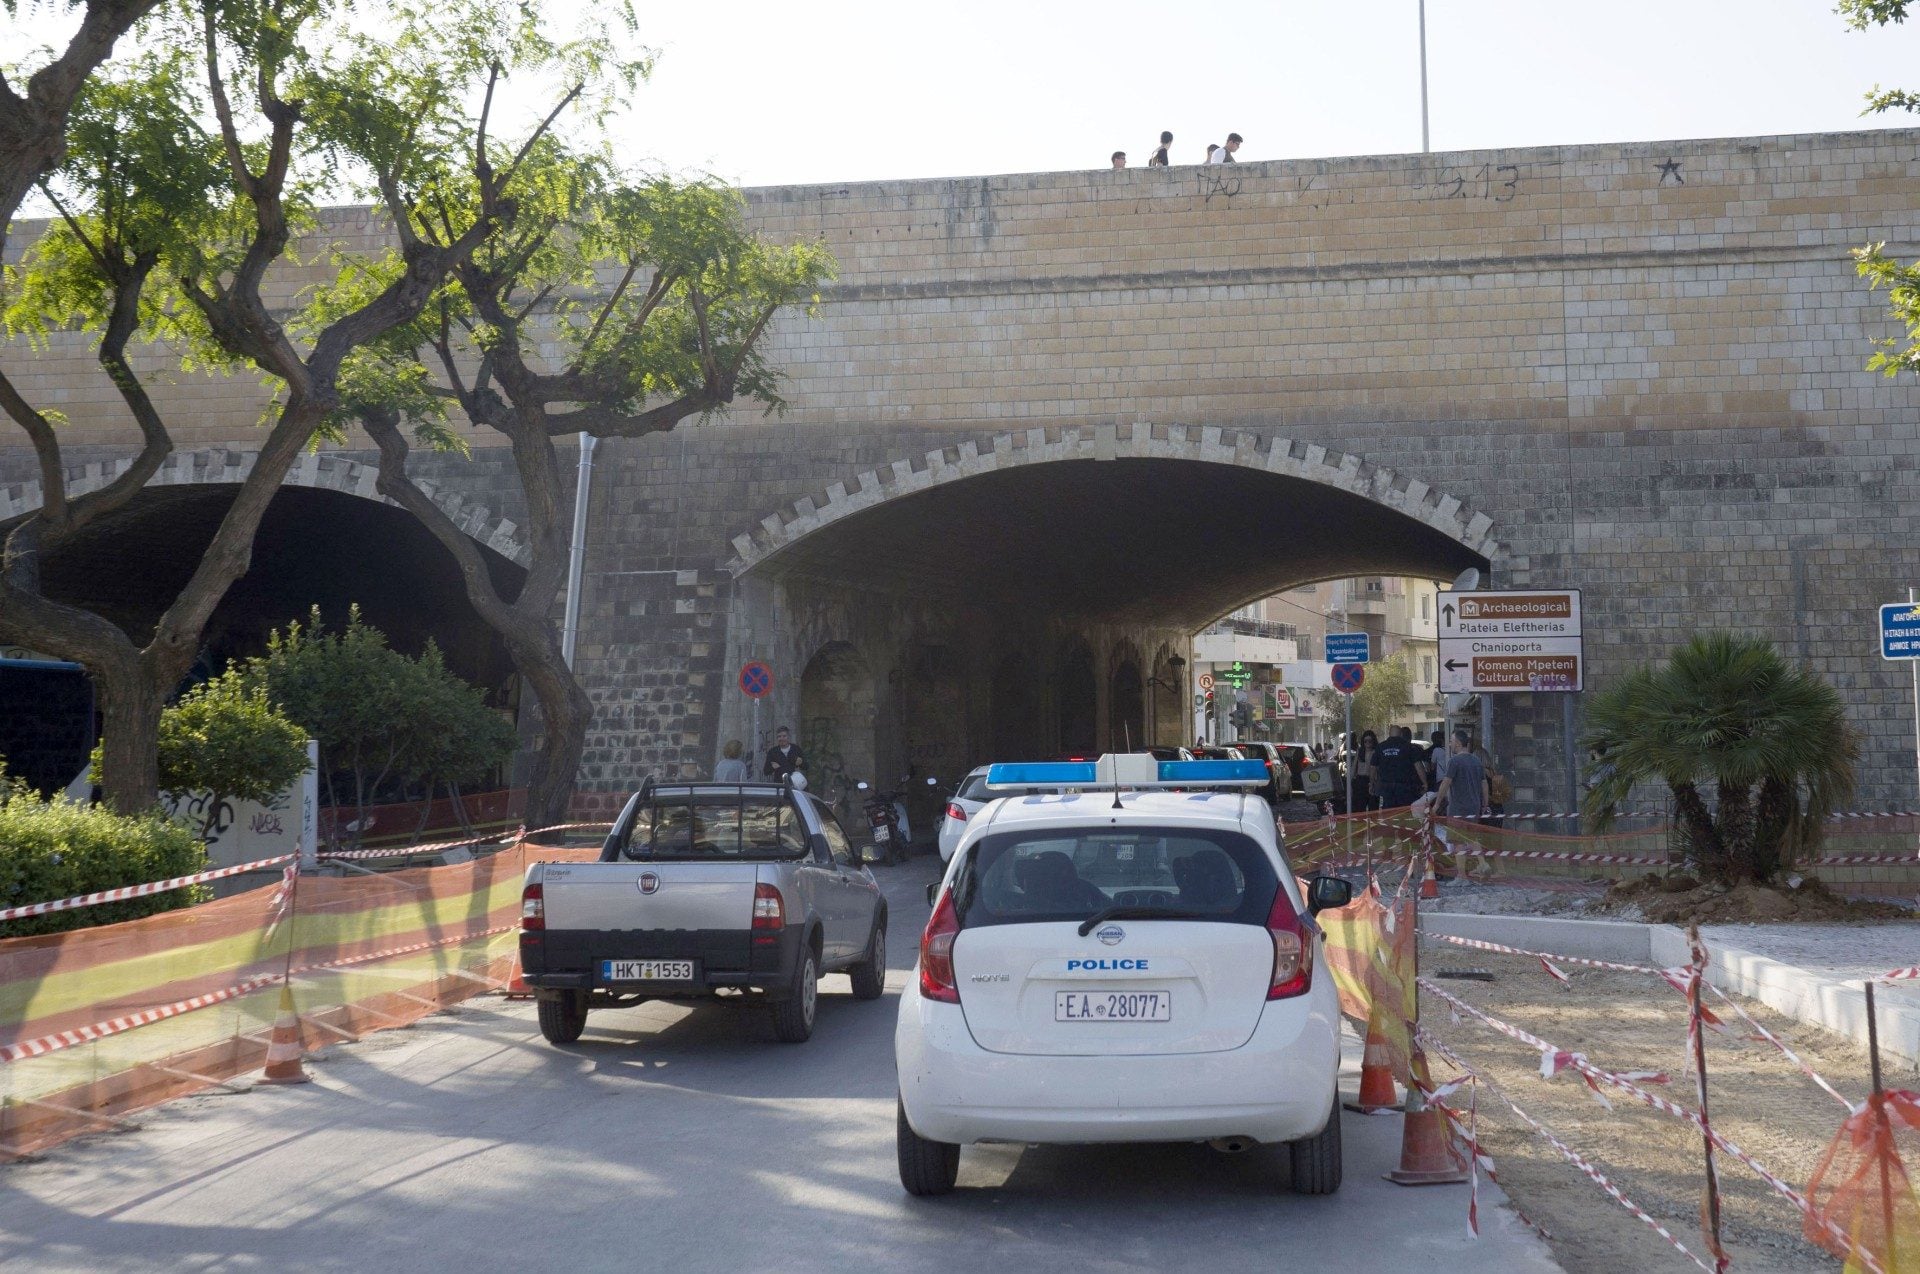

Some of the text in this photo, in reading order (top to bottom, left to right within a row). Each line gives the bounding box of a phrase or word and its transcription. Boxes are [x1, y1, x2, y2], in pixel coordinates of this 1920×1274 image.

[1482, 602, 1567, 615] Archaeological
[1460, 622, 1565, 633] Plateia Eleftherias
[1472, 642, 1542, 653] Chanioporta
[1477, 660, 1573, 672] Komeno Mpeteni
[1477, 672, 1567, 682] Cultural Centre
[1067, 959, 1149, 970] POLICE
[1108, 995, 1158, 1018] 28077
